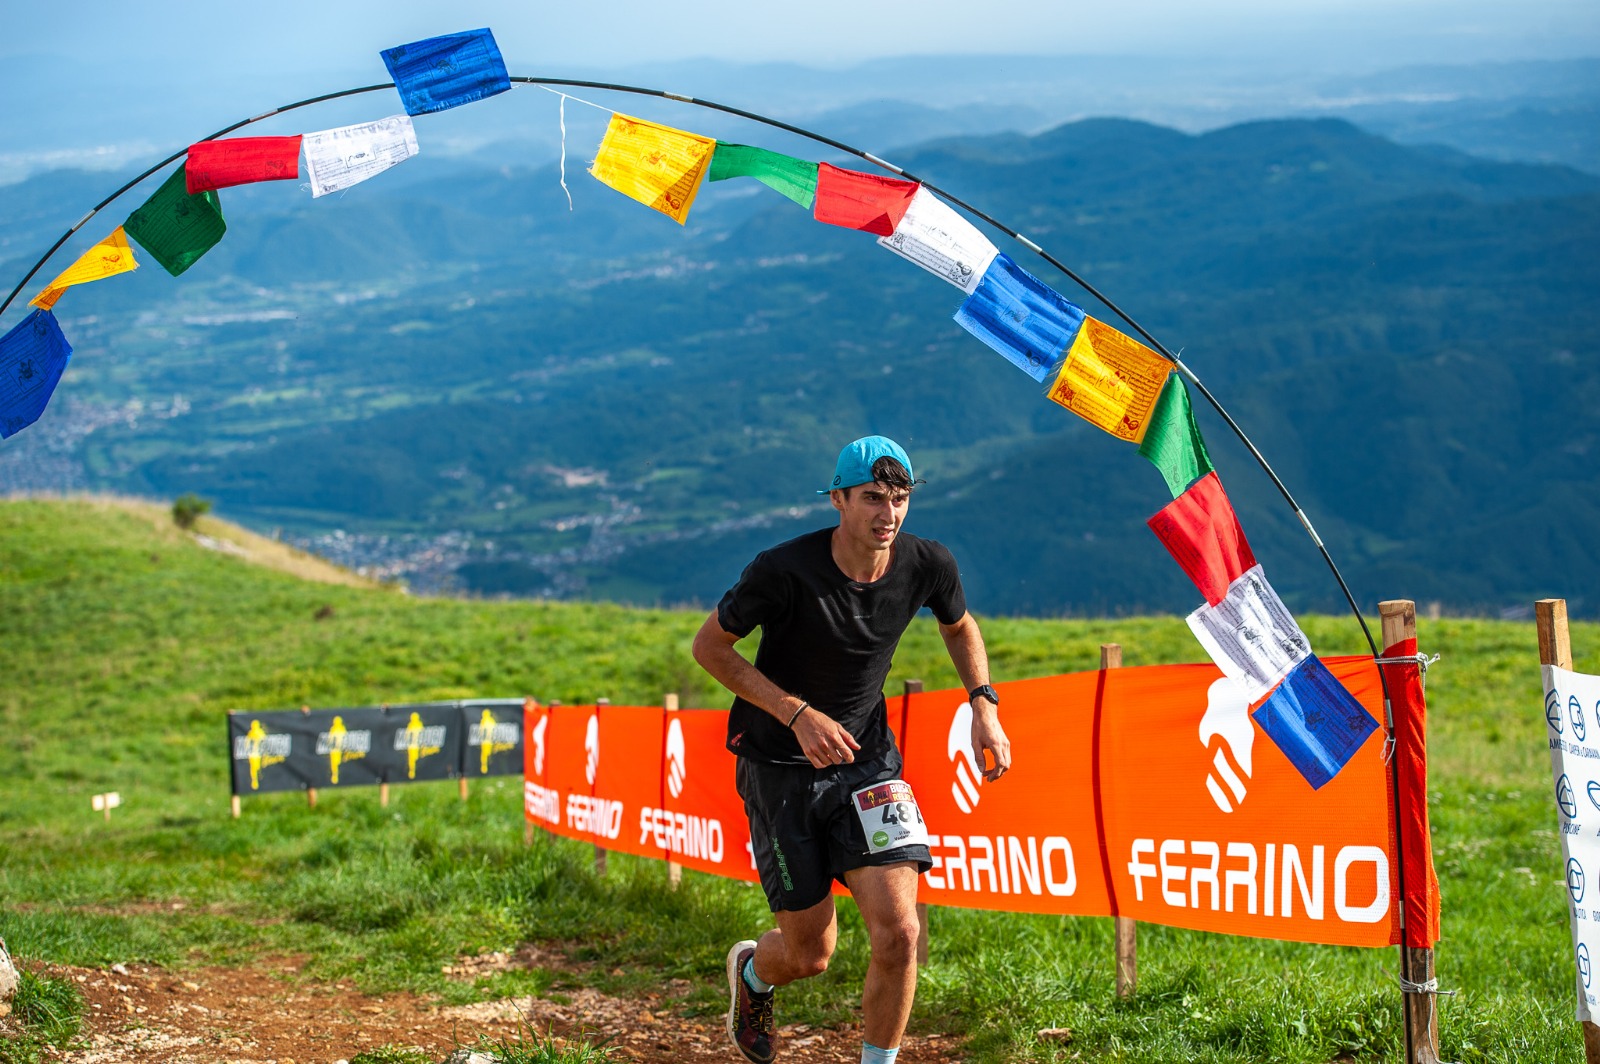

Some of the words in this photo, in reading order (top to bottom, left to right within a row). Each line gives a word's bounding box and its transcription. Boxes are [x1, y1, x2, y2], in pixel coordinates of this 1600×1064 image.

[566, 793, 624, 840] FERRINO
[639, 806, 724, 864] FERRINO
[924, 834, 1077, 897] ERRINO
[1127, 838, 1391, 923] FERRINO
